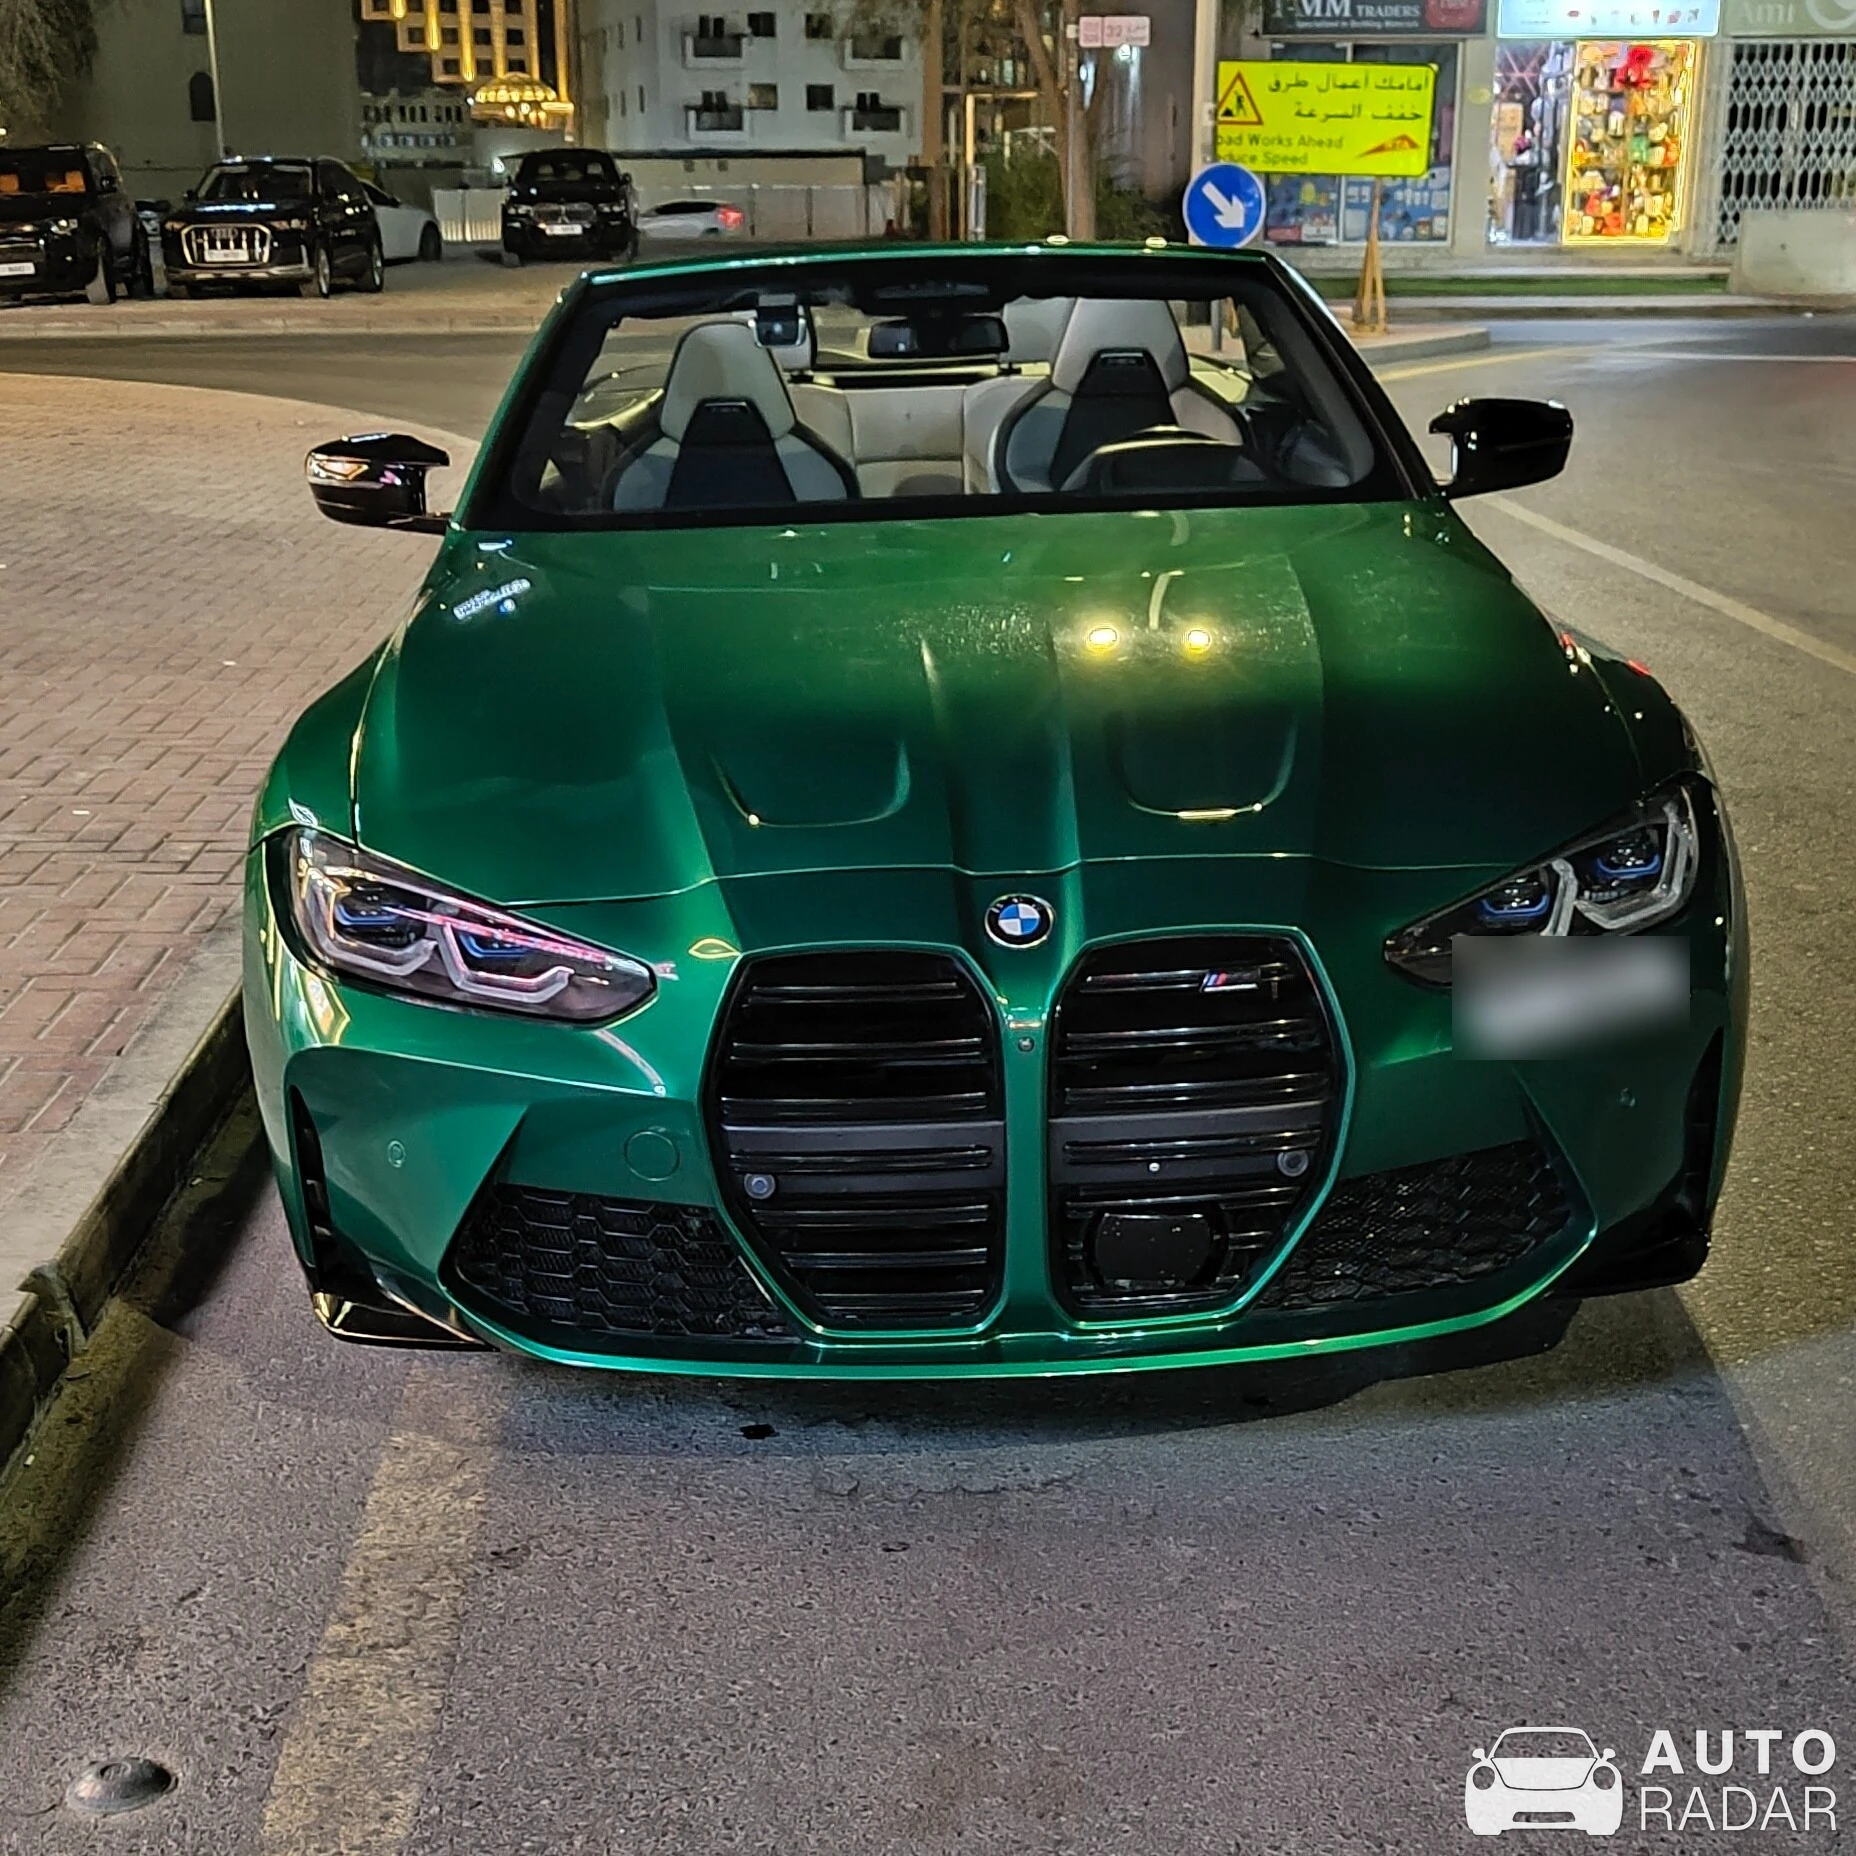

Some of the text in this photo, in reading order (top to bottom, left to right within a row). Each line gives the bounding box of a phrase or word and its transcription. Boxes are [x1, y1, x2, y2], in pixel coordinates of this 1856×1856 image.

[1356, 5, 1420, 17] TRADERS
[1268, 71, 1429, 93] أمامك أعمال طرق
[1294, 102, 1424, 122] خفف السرعة
[1217, 133, 1343, 148] oad Works Ahead
[1217, 151, 1308, 165] educe Speed
